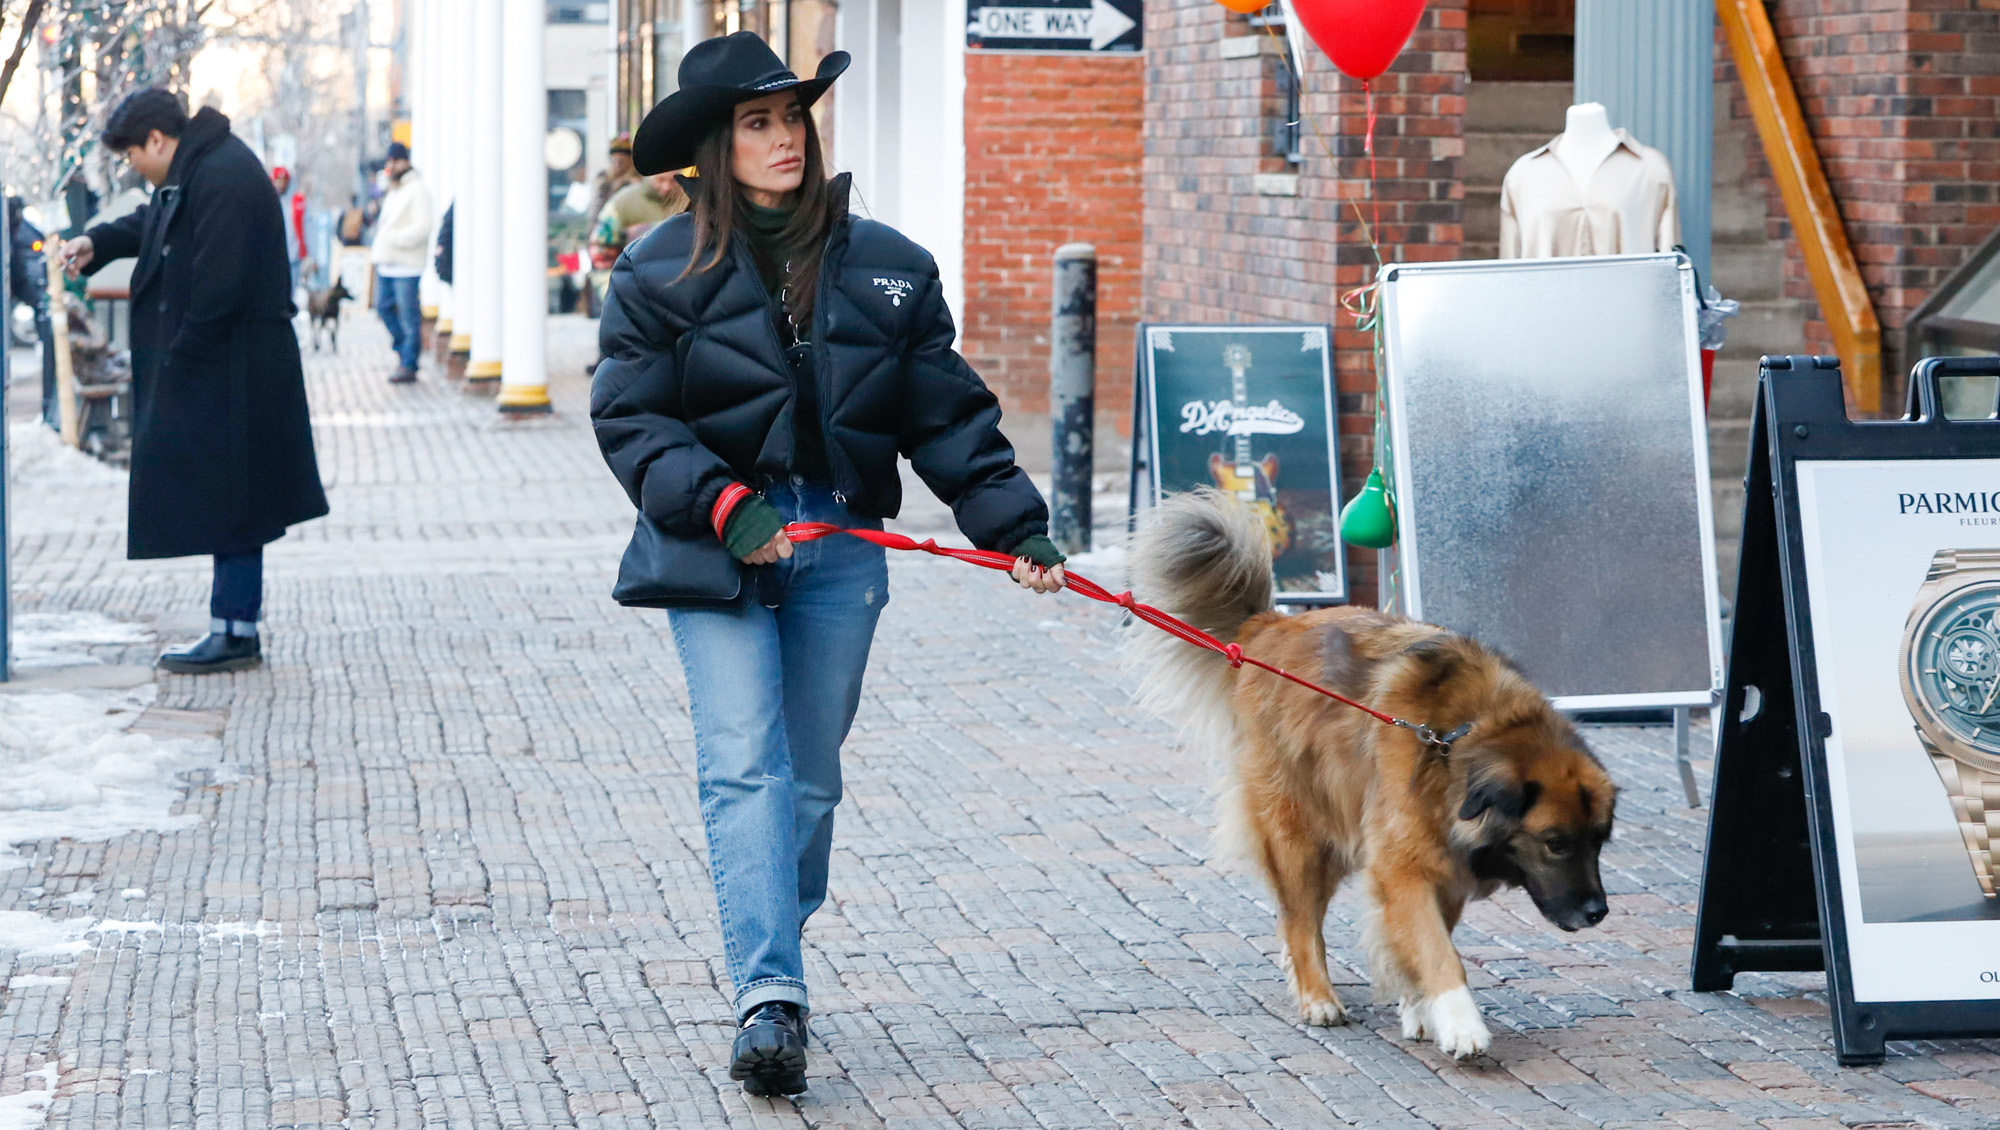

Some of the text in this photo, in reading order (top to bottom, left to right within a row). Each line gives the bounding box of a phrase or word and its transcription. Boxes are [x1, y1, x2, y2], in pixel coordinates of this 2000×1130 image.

[986, 12, 1093, 33] ONE WAY
[872, 277, 914, 291] PRADA
[1959, 517, 2000, 526] FLEUR
